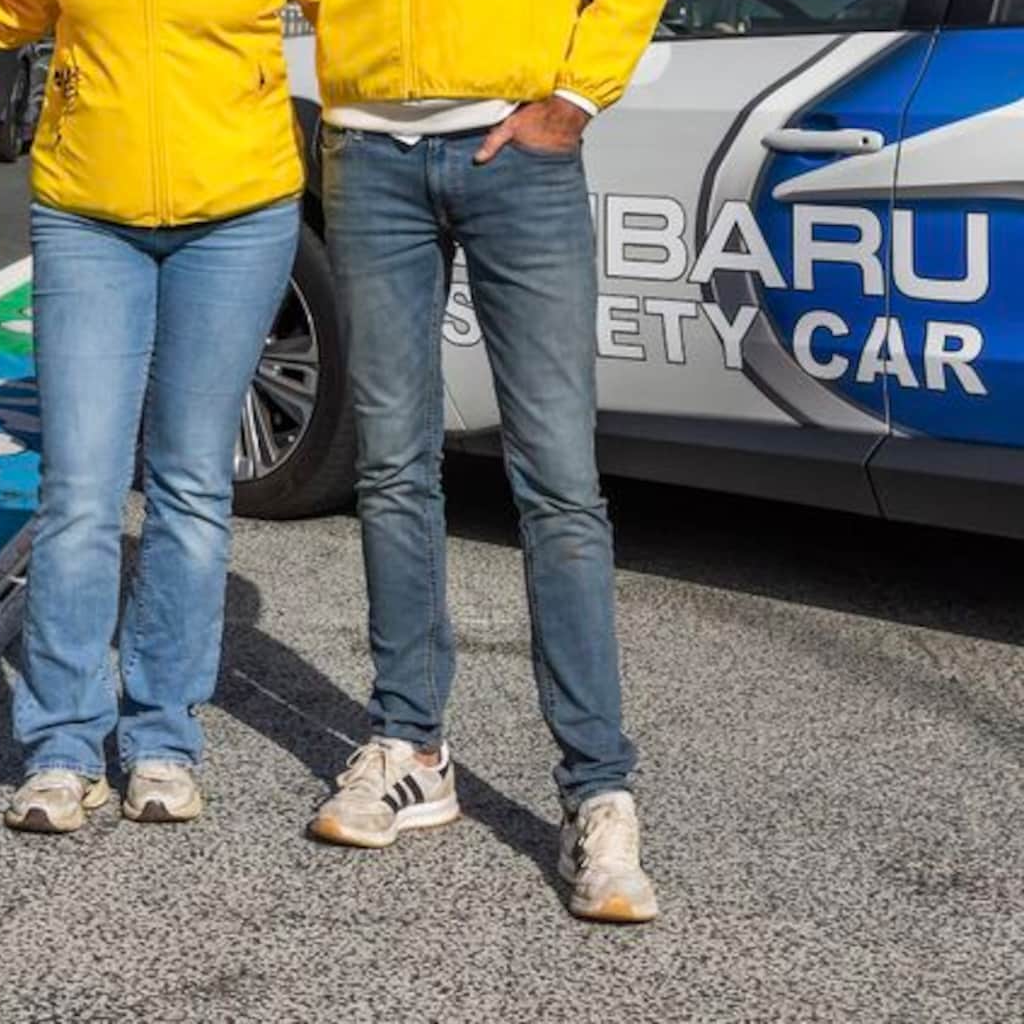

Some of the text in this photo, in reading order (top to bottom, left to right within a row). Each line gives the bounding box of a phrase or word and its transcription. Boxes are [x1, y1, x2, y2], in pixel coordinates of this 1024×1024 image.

[589, 193, 990, 304] BARU
[442, 280, 988, 396] SETY CAR
